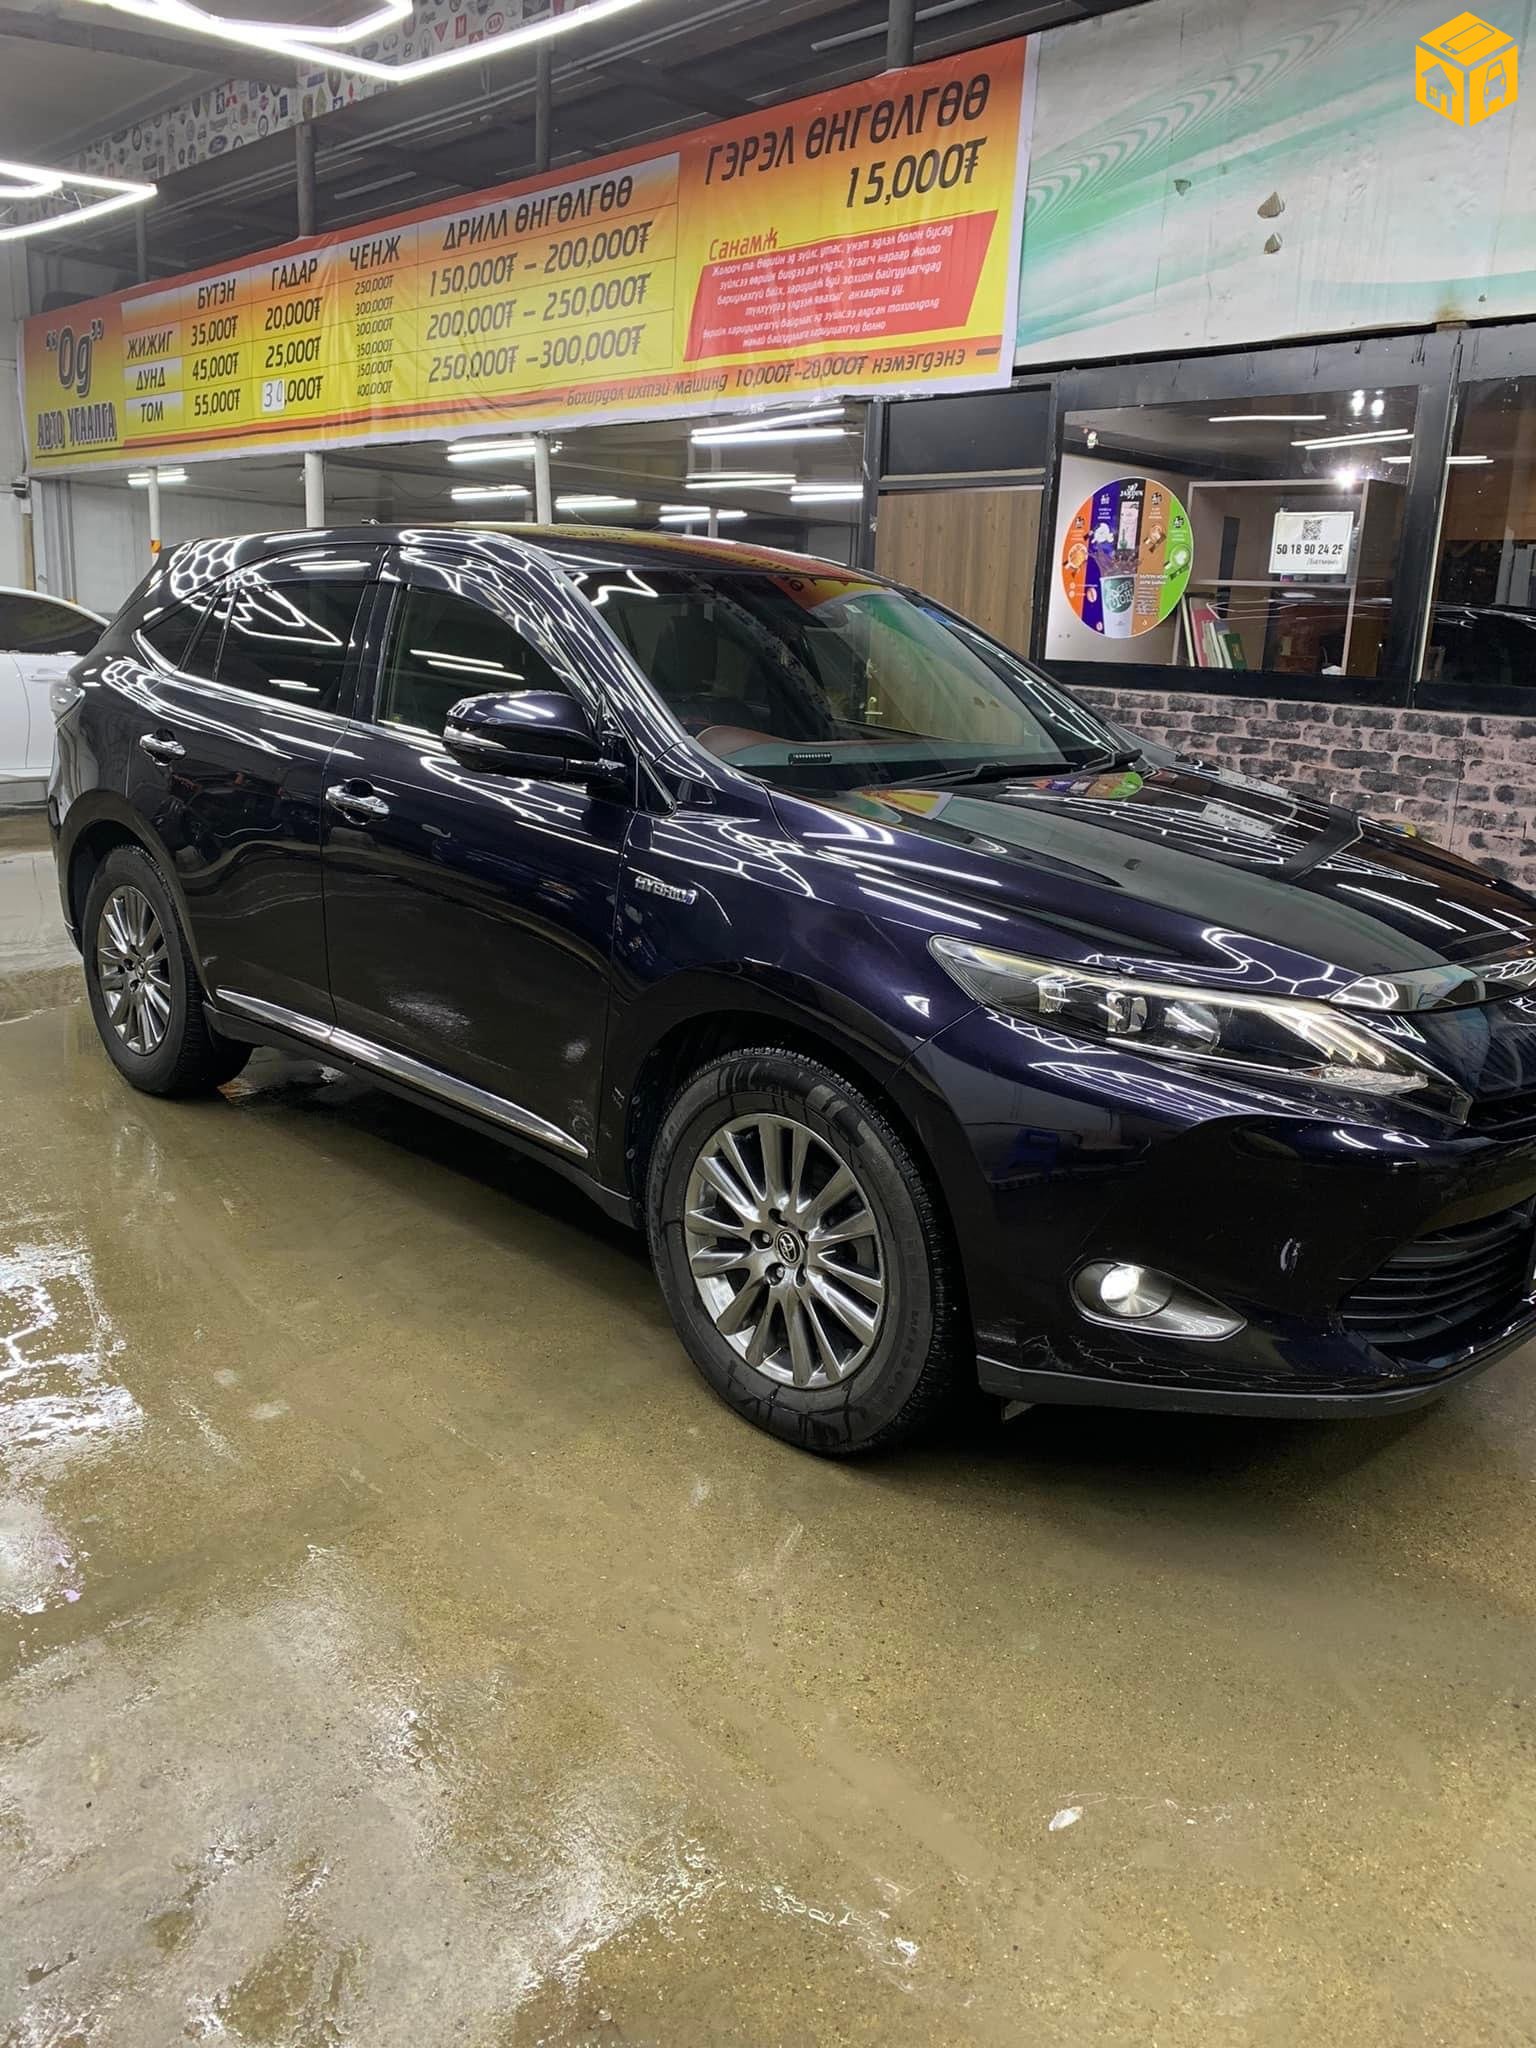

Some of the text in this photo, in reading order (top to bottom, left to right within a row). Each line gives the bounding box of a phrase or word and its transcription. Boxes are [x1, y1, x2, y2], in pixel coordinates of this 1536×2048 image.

[704, 73, 991, 184] ГЭРЭЛ ӨНГӨЛГӨӨ
[846, 136, 988, 208] 15,000₮
[442, 175, 633, 251] ДРИЛЛ ӨНГӨЛГӨӨ
[709, 227, 778, 261] Санамж
[897, 229, 924, 244] болон
[925, 224, 954, 239] бусад
[350, 235, 401, 271] ЧЕНЖ
[429, 253, 518, 297] 150,000₮
[544, 221, 653, 274] 200,000₮
[270, 257, 318, 291] ГАДАР
[843, 271, 874, 285] зохион
[197, 278, 237, 310] БҮТЭН
[426, 300, 518, 340] 200,000₮
[543, 272, 652, 321] 250,000₮
[848, 284, 890, 300] анхаарна
[887, 298, 940, 313] тохиолдолд
[264, 297, 324, 331] 20,000₮
[862, 320, 887, 334] болно
[127, 330, 173, 360] ЖИЖИГ
[191, 315, 239, 347] 35,000₮
[192, 352, 240, 382] 45,000₮
[265, 336, 322, 369] 25,000₮
[428, 345, 519, 383] 250,000₮
[136, 366, 166, 391] ДУНД
[567, 388, 624, 407] Бохирдол
[627, 382, 670, 400] ихтэй
[672, 372, 728, 395] машинд
[872, 348, 965, 374] нэмэгдэнэ
[140, 400, 164, 423] ТОМ
[194, 388, 242, 417] 55,000₮
[37, 402, 118, 449] АВТО УГААЛГА
[1276, 543, 1287, 555] 50
[1291, 543, 1302, 555] 18
[1304, 543, 1316, 555] 90
[1317, 543, 1330, 555] 24
[634, 875, 687, 902] HYBRID
